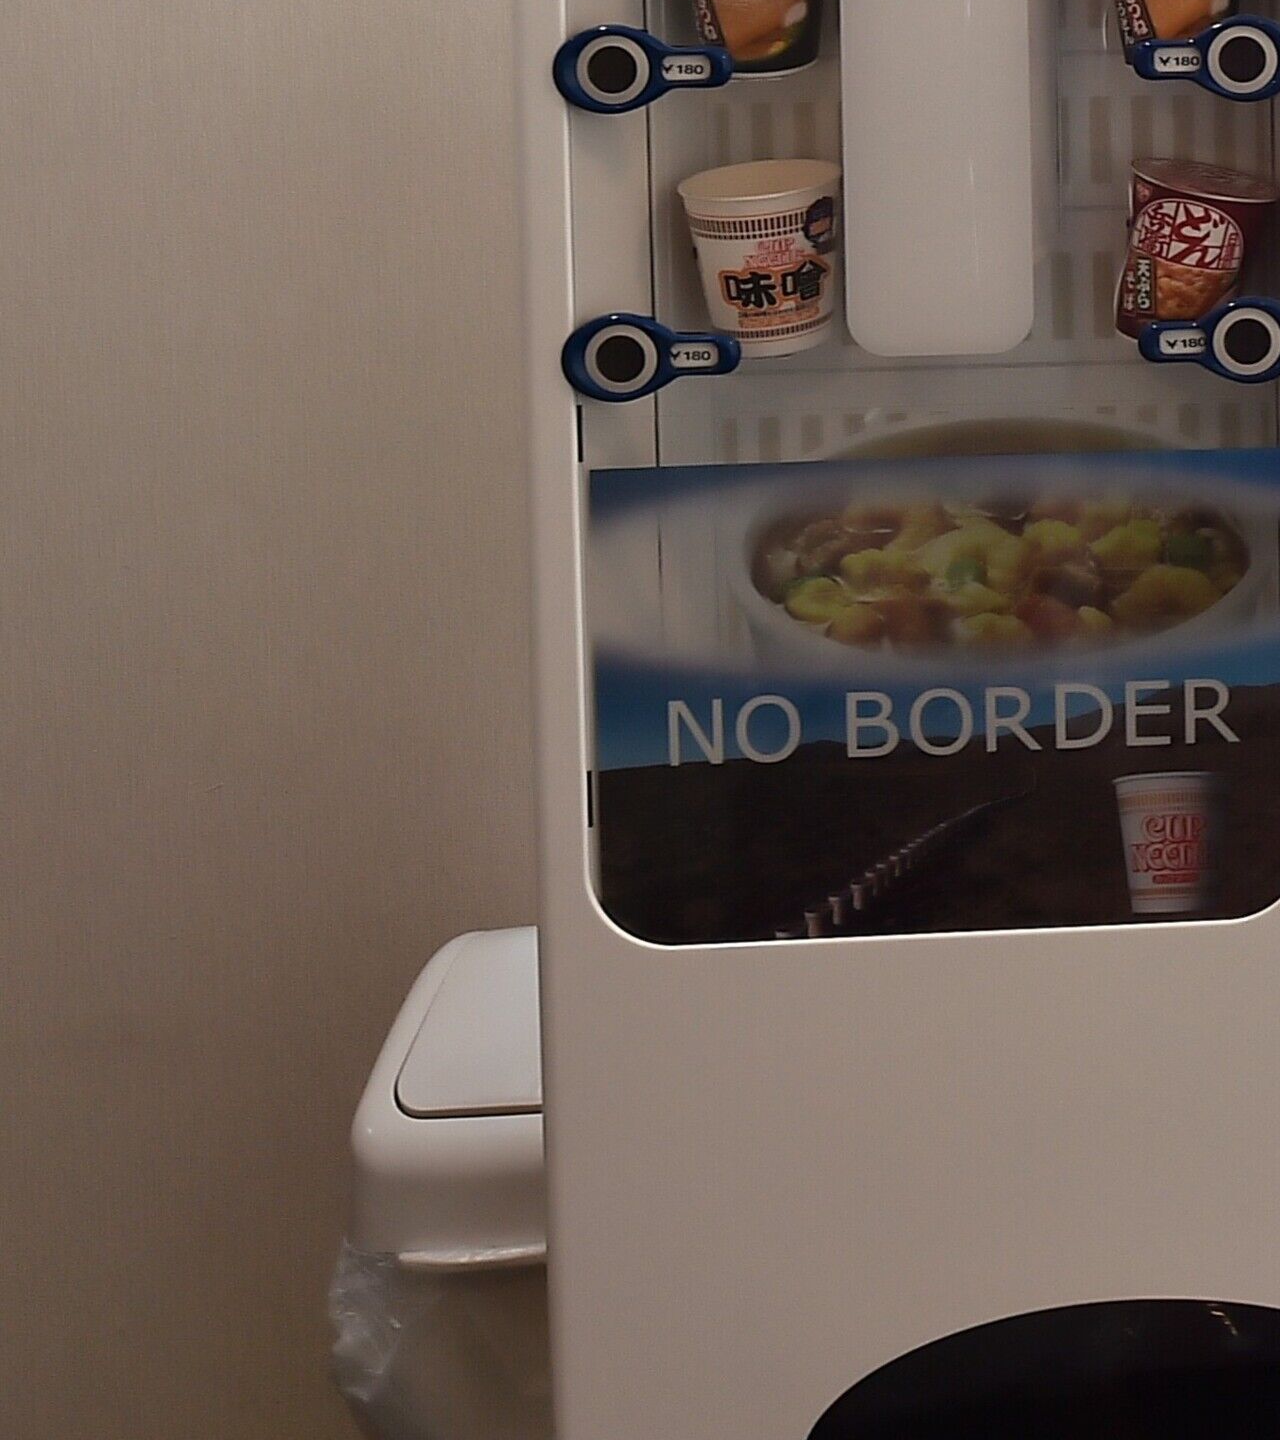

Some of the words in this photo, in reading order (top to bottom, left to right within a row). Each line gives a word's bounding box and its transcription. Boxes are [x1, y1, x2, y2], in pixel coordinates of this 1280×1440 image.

[723, 259, 828, 308] 味噌
[666, 695, 803, 767] NO
[845, 677, 1241, 759] BORDER
